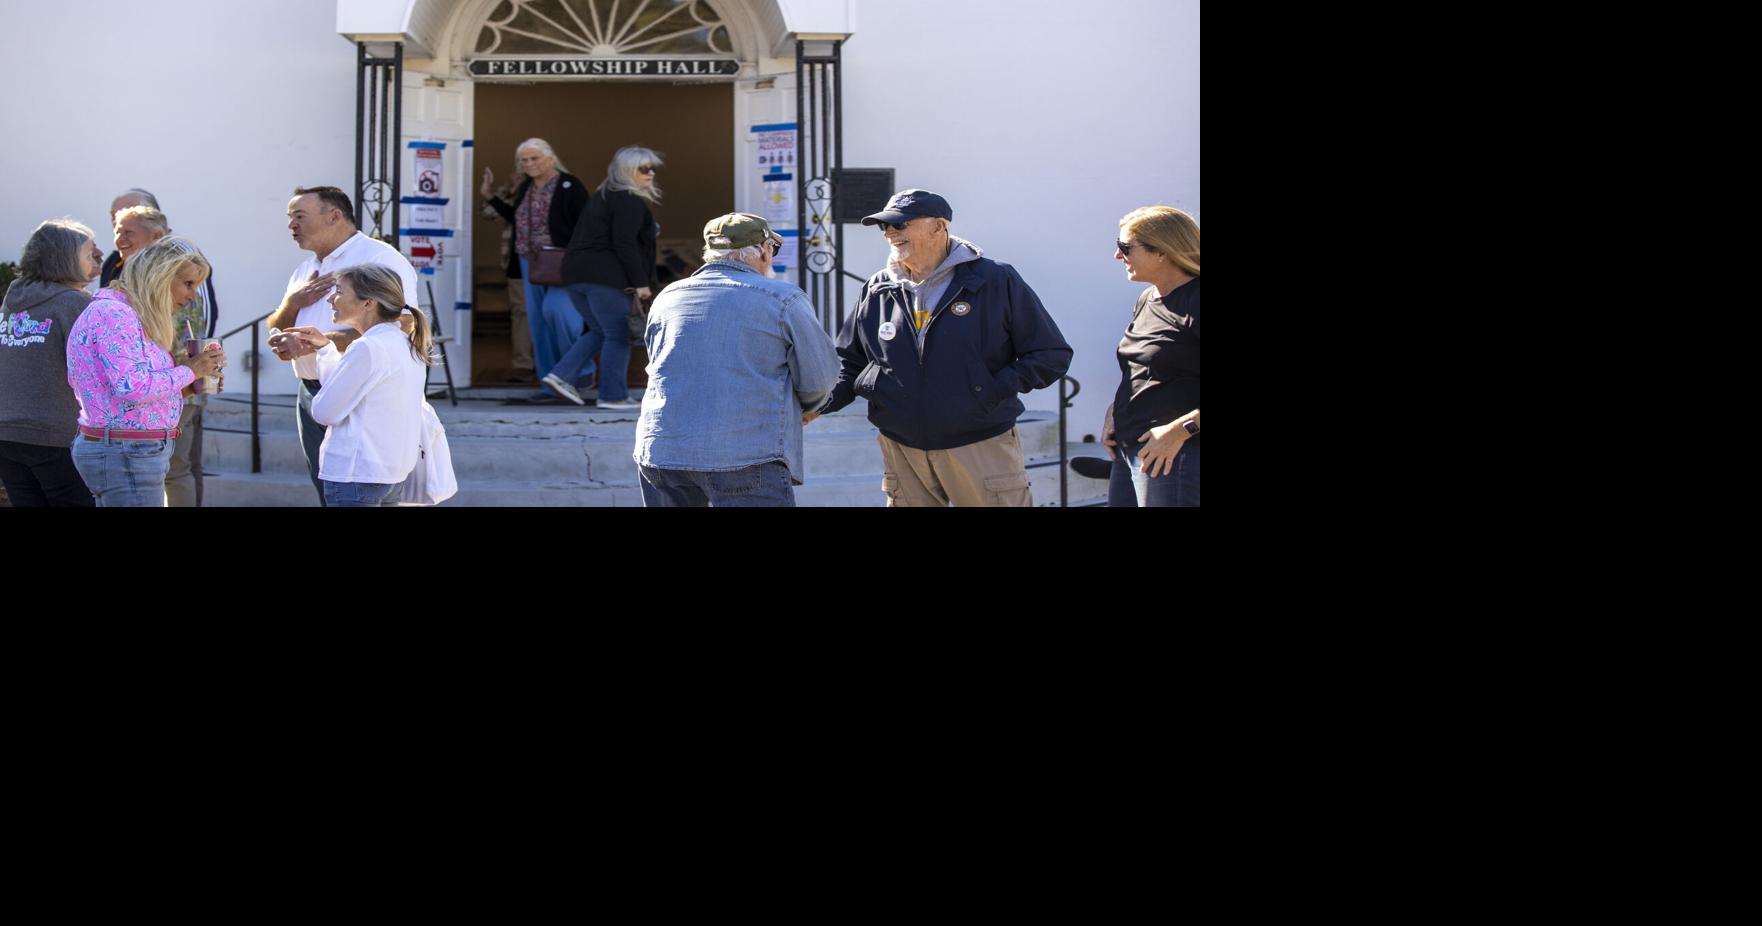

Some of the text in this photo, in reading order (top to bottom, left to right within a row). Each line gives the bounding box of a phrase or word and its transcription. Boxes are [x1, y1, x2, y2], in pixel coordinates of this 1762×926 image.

[488, 61, 722, 74] FELLOWSHIP HALL
[8, 335, 46, 347] Everyone
